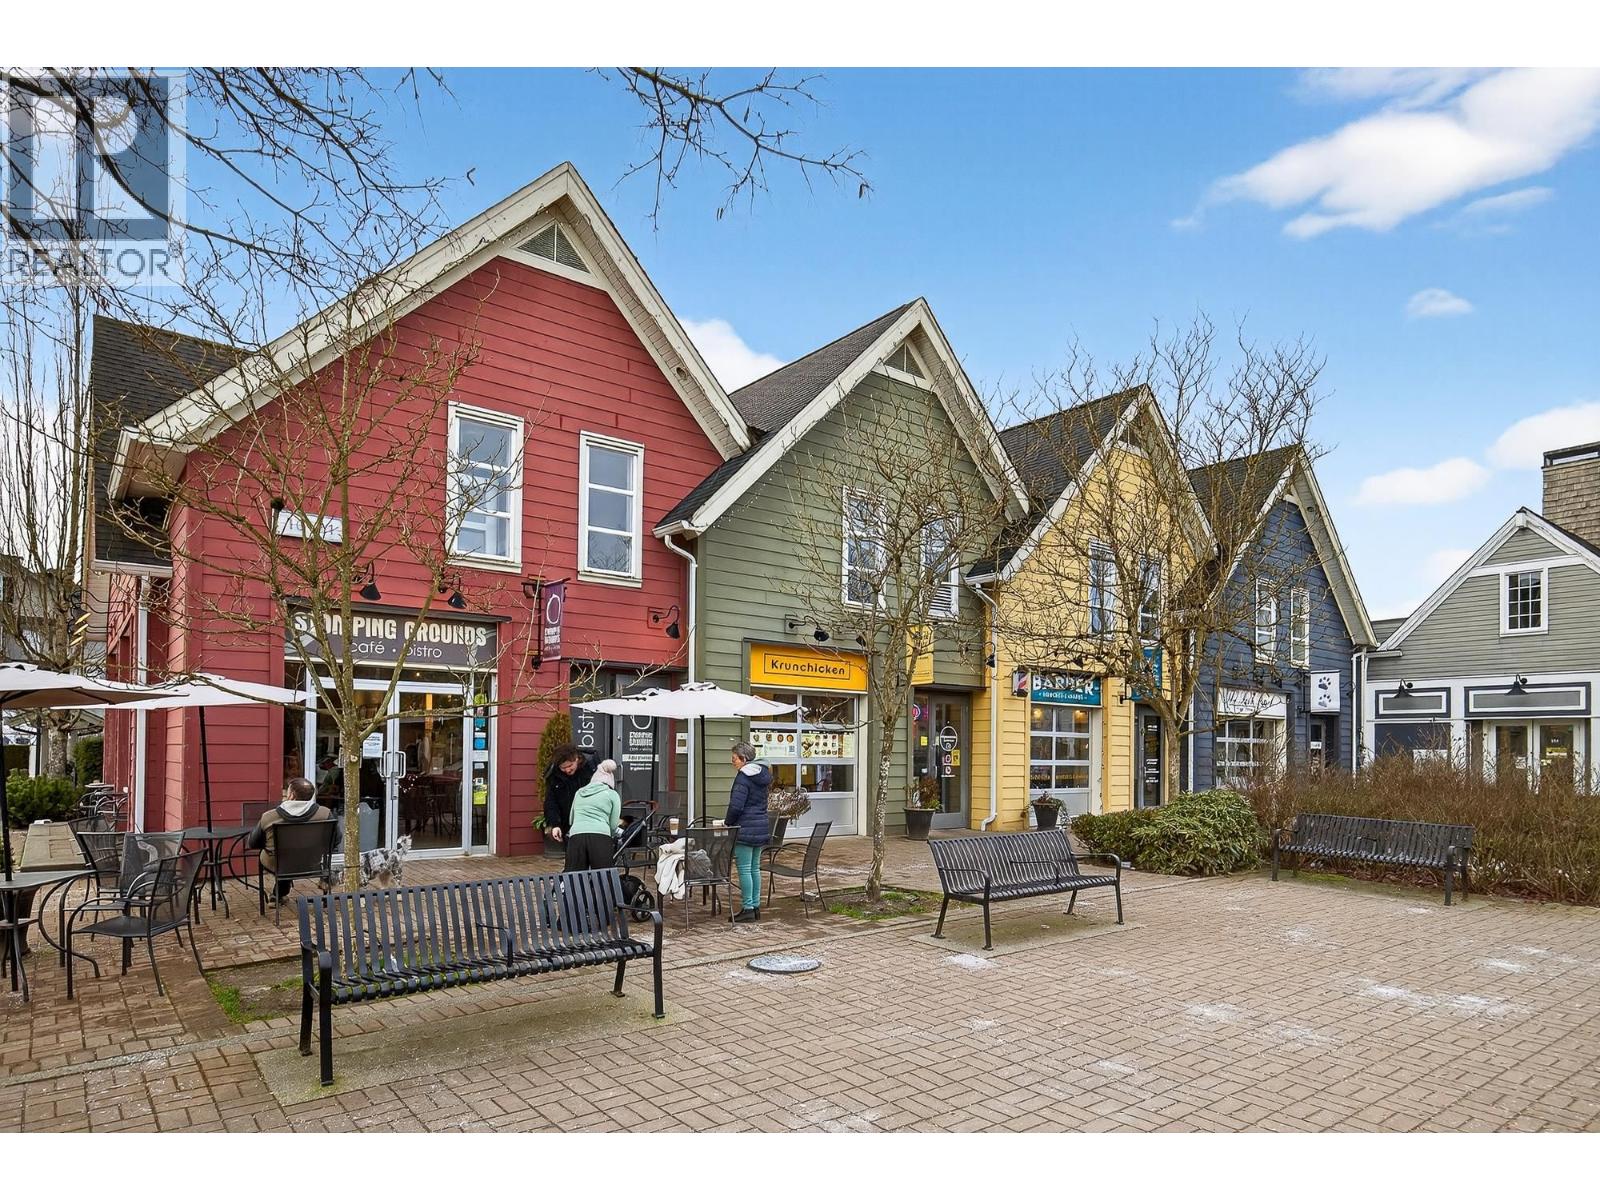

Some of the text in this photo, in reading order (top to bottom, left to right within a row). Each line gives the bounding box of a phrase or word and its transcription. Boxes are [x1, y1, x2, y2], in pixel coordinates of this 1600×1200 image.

[404, 621, 487, 647] GROUNDS
[351, 641, 384, 654] café
[771, 659, 845, 675] Krunchicken
